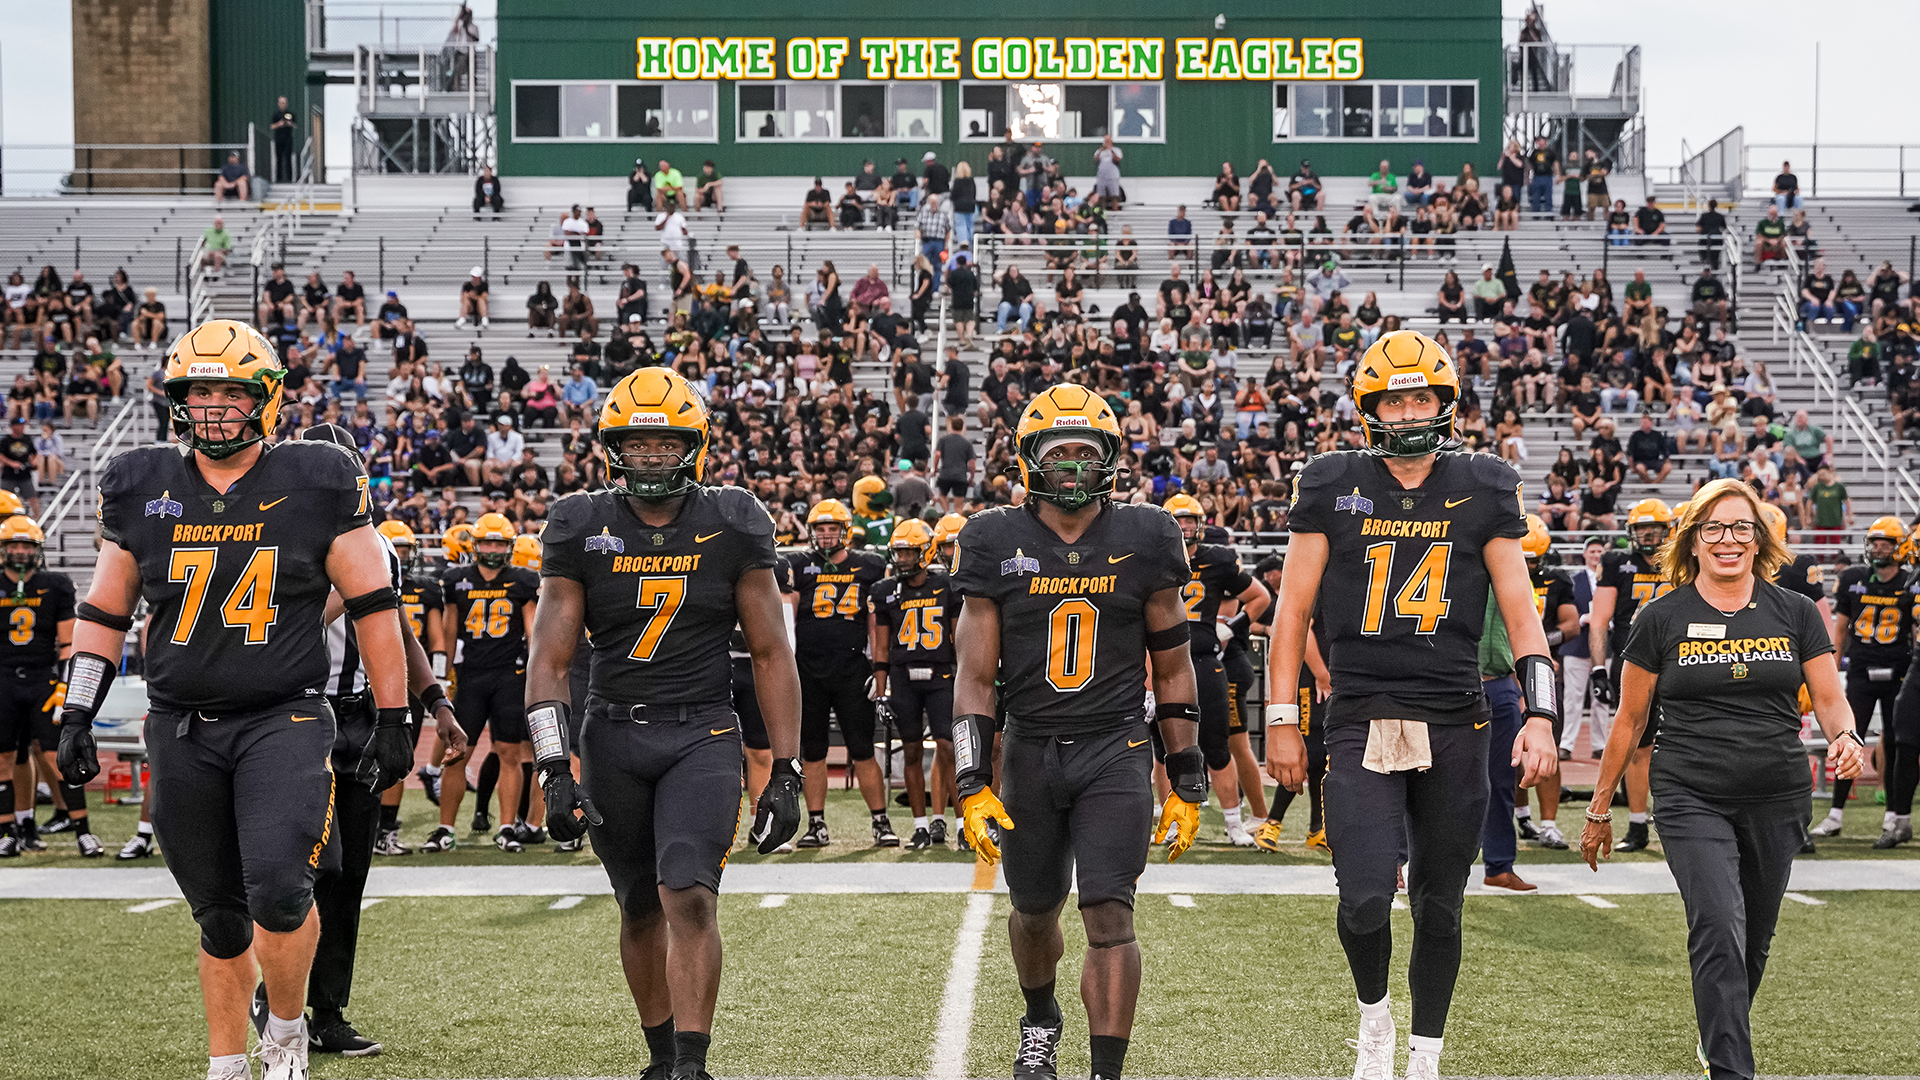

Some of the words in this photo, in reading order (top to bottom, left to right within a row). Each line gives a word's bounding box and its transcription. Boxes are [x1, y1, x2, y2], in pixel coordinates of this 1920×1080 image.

[637, 37, 776, 79] HOME
[787, 37, 849, 79] OF
[861, 37, 961, 79] THE
[972, 37, 1165, 80] GOLDEN
[1176, 37, 1364, 80] EAGLES
[190, 366, 224, 374] Riddell
[1391, 375, 1424, 386] Riddell
[632, 416, 665, 424] Riddell
[172, 523, 264, 542] BROCKPORT
[1361, 518, 1451, 538] BROCKPORT
[612, 554, 701, 572] BROCKPORT
[816, 574, 855, 583] BROCKPORT
[1029, 575, 1117, 595] BROCKPORT
[1361, 541, 1453, 635] 14
[168, 546, 279, 645] 74
[467, 589, 508, 600] BROCKPORT
[812, 583, 861, 621] 64
[1179, 580, 1205, 622] 2
[9, 607, 36, 646] 3
[465, 598, 513, 639] 46
[627, 575, 687, 662] 7
[898, 606, 943, 650] 45
[1854, 605, 1901, 645] 48
[1045, 597, 1100, 692] 0
[1679, 637, 1790, 658] BROCKPORT
[1678, 652, 1739, 667] GOLDEN
[1742, 650, 1794, 662] EAGLES
[1731, 662, 1749, 679] B
